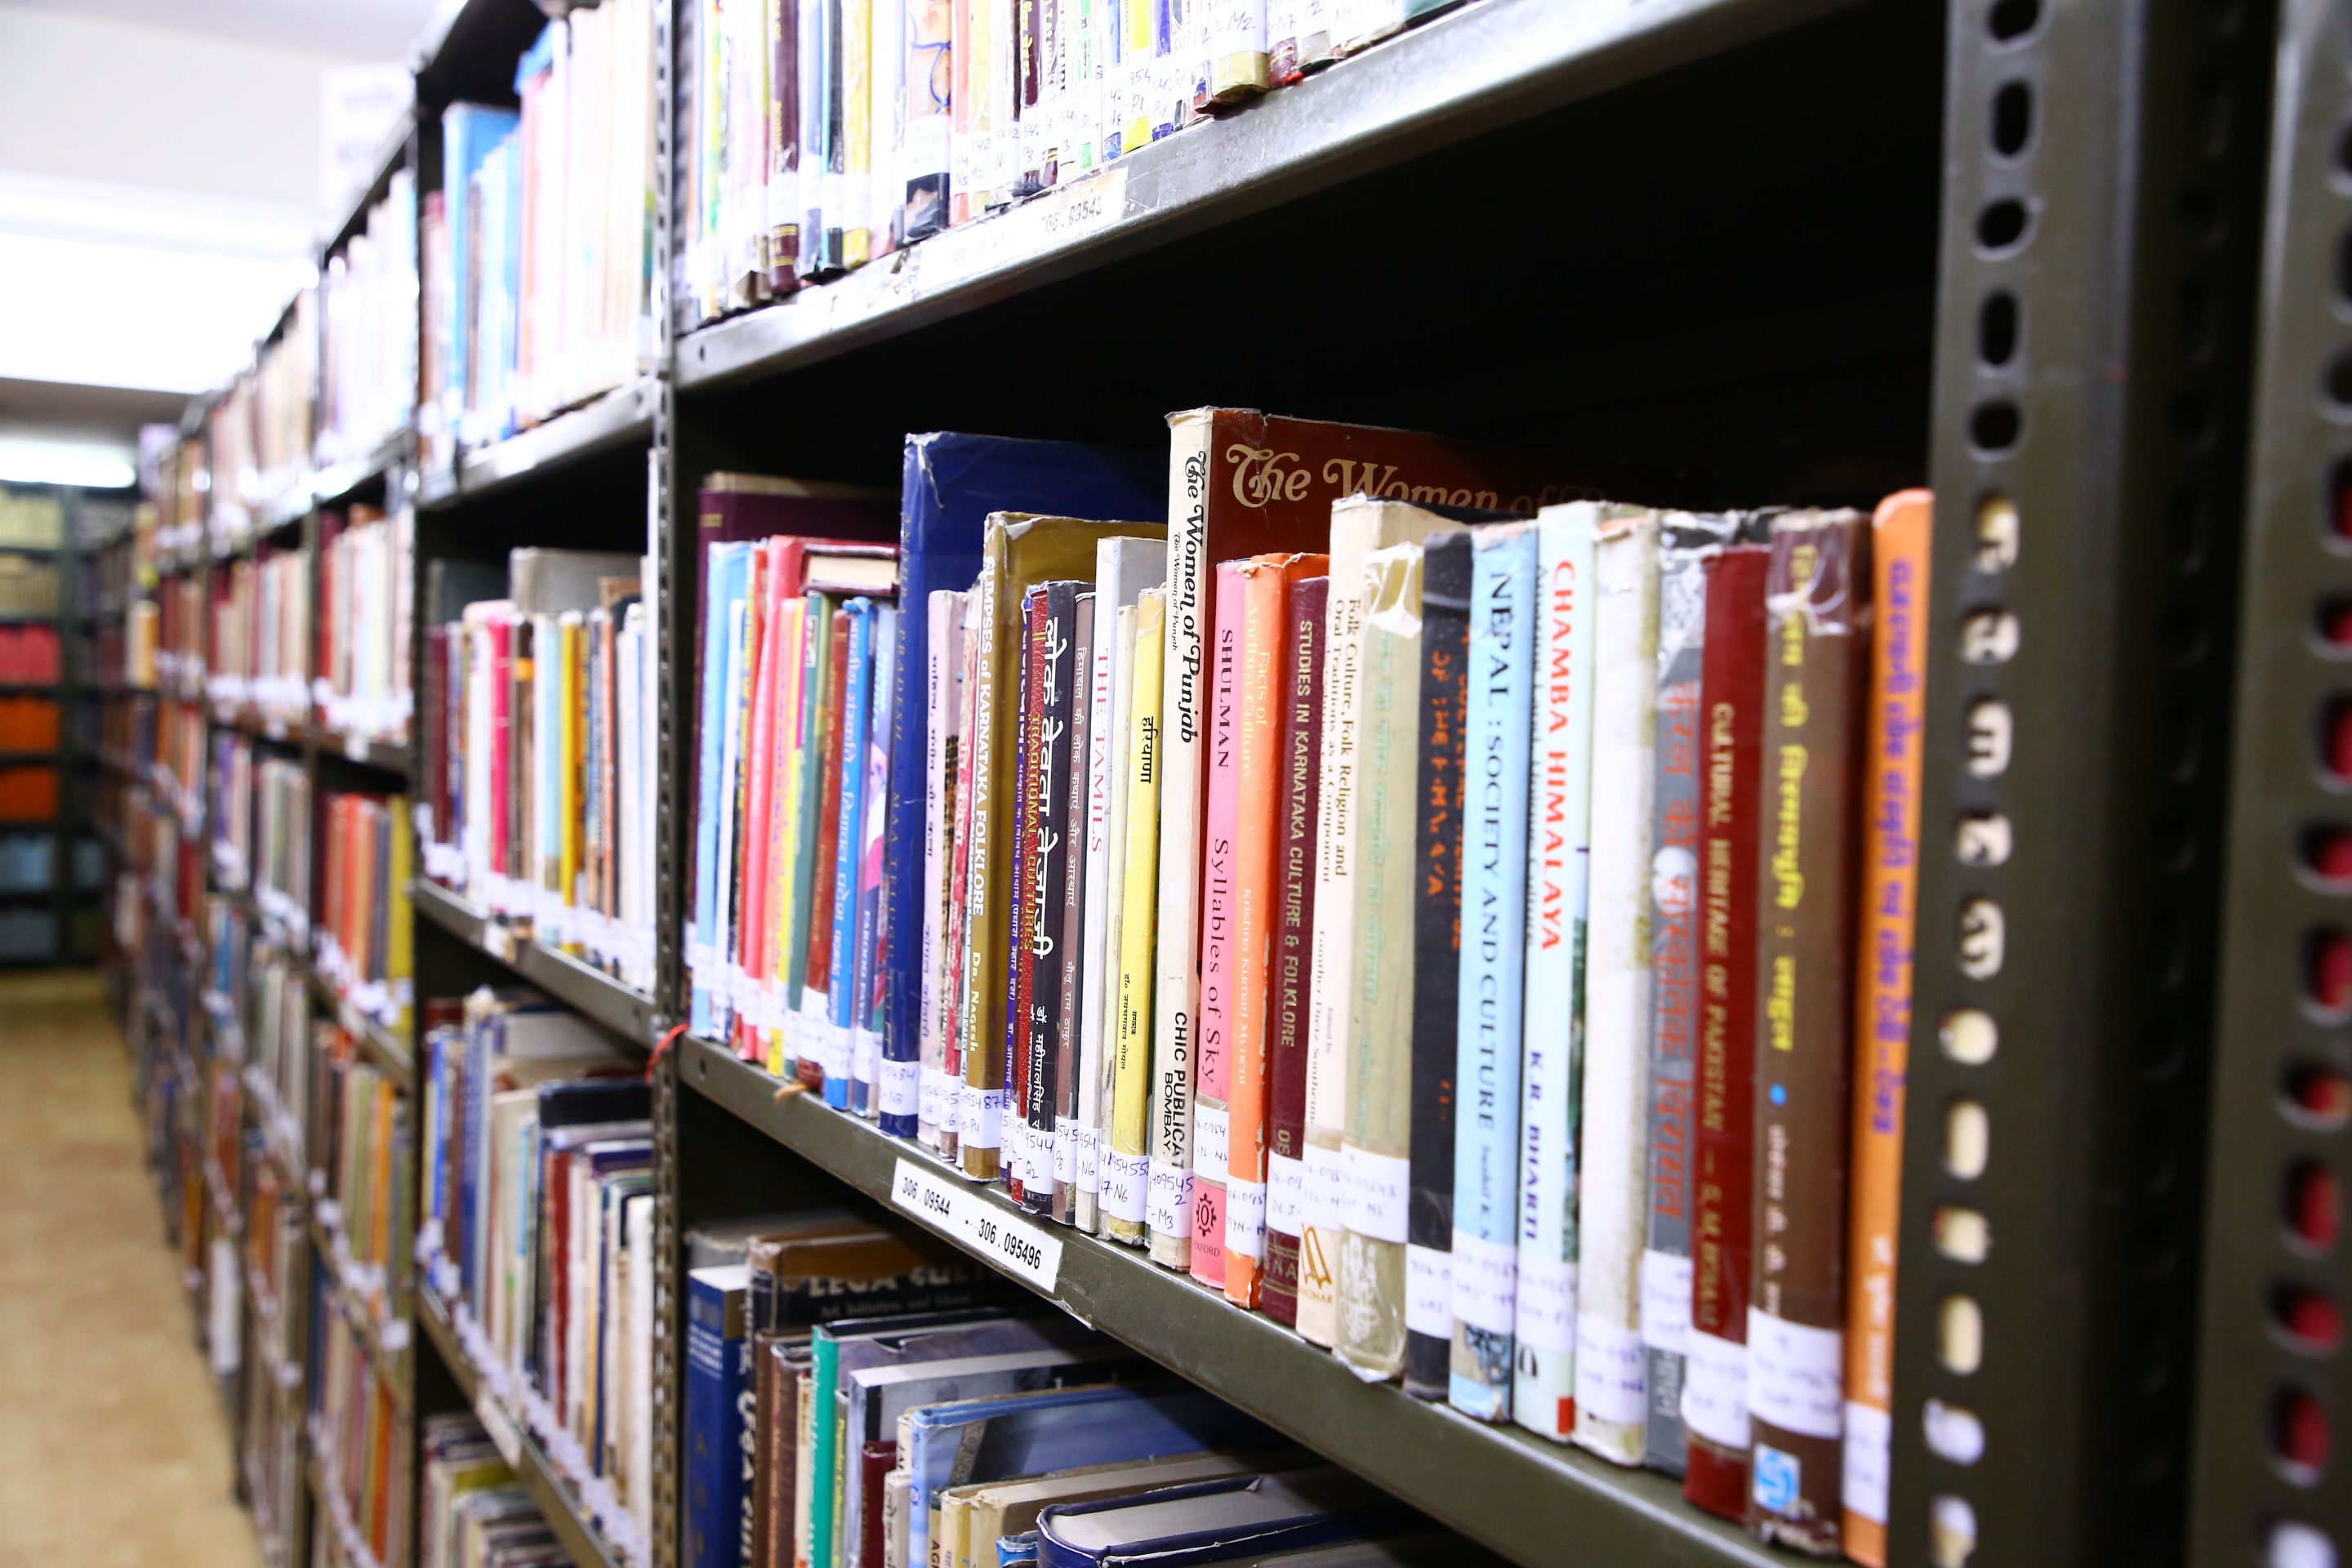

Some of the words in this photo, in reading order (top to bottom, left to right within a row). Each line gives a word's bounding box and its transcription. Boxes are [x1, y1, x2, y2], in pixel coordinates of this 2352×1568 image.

[1184, 451, 1207, 499] The
[1226, 443, 1312, 508] The
[1323, 459, 1498, 510] Women
[1171, 555, 1181, 597] Women
[1173, 532, 1182, 552] The
[1179, 505, 1205, 612] Women
[981, 555, 996, 654] GLIMPSES
[1171, 612, 1180, 651] Punjab
[1172, 599, 1180, 610] of
[1183, 615, 1201, 642] of
[1334, 599, 1346, 636] Oral
[1348, 598, 1362, 635] Folk
[979, 659, 992, 679] of
[1043, 616, 1068, 707] लोक
[1075, 646, 1088, 700] हिमाचल
[1245, 605, 1259, 684] Andhra
[1296, 620, 1312, 697] STUDIES
[1488, 572, 1515, 707] NEPAL
[1548, 559, 1576, 734] CHAMBA
[893, 629, 907, 741] PRADESH
[1096, 648, 1109, 715] THE
[1178, 644, 1201, 743] Punjab
[1218, 629, 1234, 768] SHULMAN
[1256, 651, 1271, 702] Facts
[1329, 645, 1343, 733] Traditions
[1341, 643, 1359, 716] Culture,
[974, 684, 991, 804] KARNATAKA
[1072, 707, 1085, 726] की
[1241, 694, 1255, 777] Culture
[1255, 707, 1268, 726] of
[1295, 703, 1310, 723] IN
[1340, 719, 1356, 756] Folk
[1026, 712, 1042, 838] TRADITIONAL
[1038, 715, 1064, 817] देवता
[1071, 734, 1084, 764] लोक
[1140, 715, 1158, 784] हरियाणा
[1328, 741, 1336, 758] as
[1708, 702, 1735, 827] CULTURAL
[1091, 728, 1107, 853] TAMILS
[1290, 730, 1309, 840] KARNATAKA
[1335, 764, 1352, 836] Religion
[1481, 736, 1504, 876] SOCIETY
[972, 809, 987, 916] FOLKLORE
[1067, 818, 1080, 848] और
[1322, 782, 1337, 883] Component
[1335, 844, 1348, 876] and
[1540, 750, 1568, 951] HIMALAYA
[1023, 854, 1038, 951] CULTURES
[1209, 838, 1229, 973] Syllables
[1241, 888, 1252, 951] Krishna
[1285, 846, 1304, 928] CULTURE
[1706, 838, 1732, 959] HERITAGE
[1285, 934, 1299, 948] &
[1480, 887, 1500, 962] AND
[1035, 1005, 1048, 1026] डॉ.
[1062, 990, 1072, 1011] राम
[1208, 986, 1223, 1018] of
[1240, 957, 1250, 1018] Kumari
[1281, 955, 1299, 1048] FOLKLORE
[1704, 964, 1728, 1000] OF
[1061, 1018, 1073, 1049] ठाकुर
[1120, 1044, 1129, 1071] गोयल
[1172, 1011, 1188, 1062] CHIC
[1202, 1027, 1221, 1085] Sky
[1237, 1022, 1249, 1085] Myneni
[1477, 974, 1498, 1132] CULTURE
[1703, 1004, 1727, 1133] PAKISTAN
[1164, 1072, 1174, 1155] BOMBAY.
[1525, 1125, 1543, 1241] BHARTI
[978, 1218, 1042, 1271] 306.095496
[1193, 1241, 1220, 1257] OXFORD
